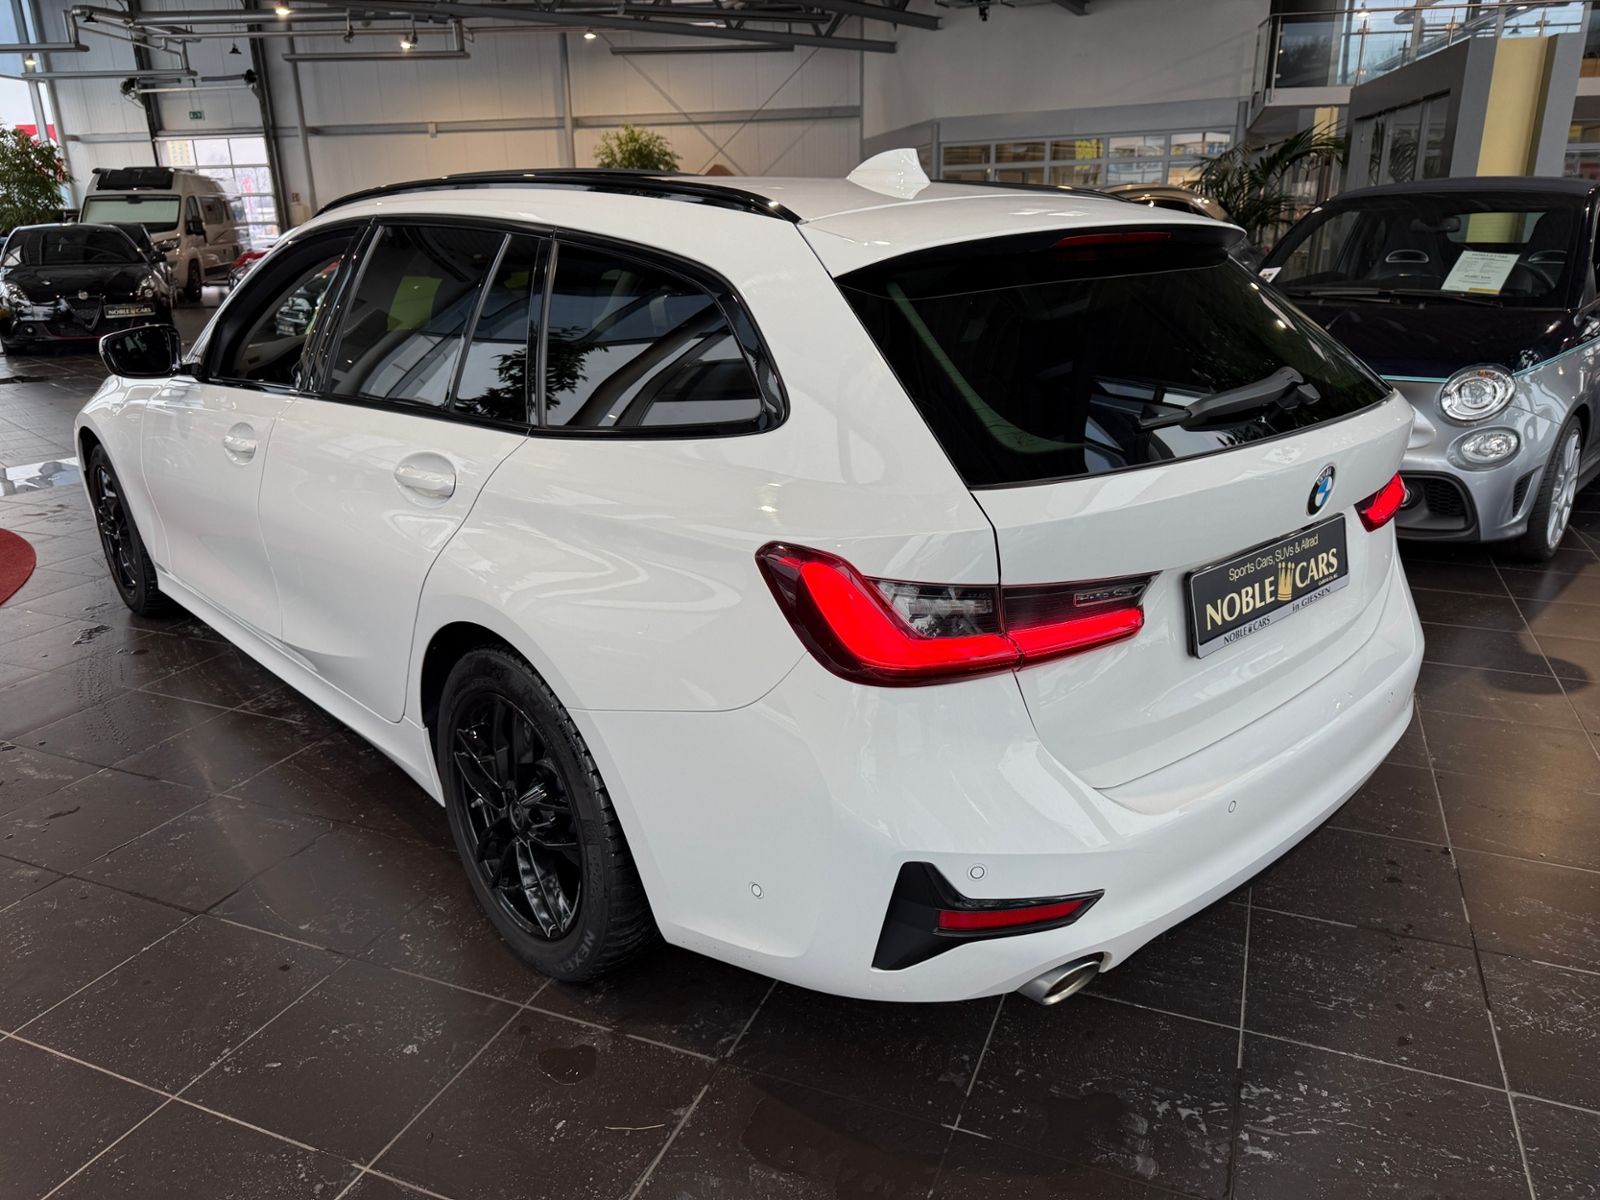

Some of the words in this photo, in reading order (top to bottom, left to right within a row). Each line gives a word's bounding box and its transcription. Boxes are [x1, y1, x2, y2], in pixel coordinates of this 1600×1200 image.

[1228, 562, 1255, 582] Sports
[1255, 554, 1276, 571] Cars,
[1275, 545, 1294, 562] SUVs
[1295, 542, 1301, 553] &
[1300, 534, 1319, 552] Allrad
[1205, 576, 1276, 631] NOBLE
[1295, 548, 1338, 588] CARS
[1223, 625, 1248, 645] NOBLE
[1252, 617, 1271, 632] CARS
[1291, 603, 1301, 613] in
[1301, 586, 1331, 606] GIESSEN
